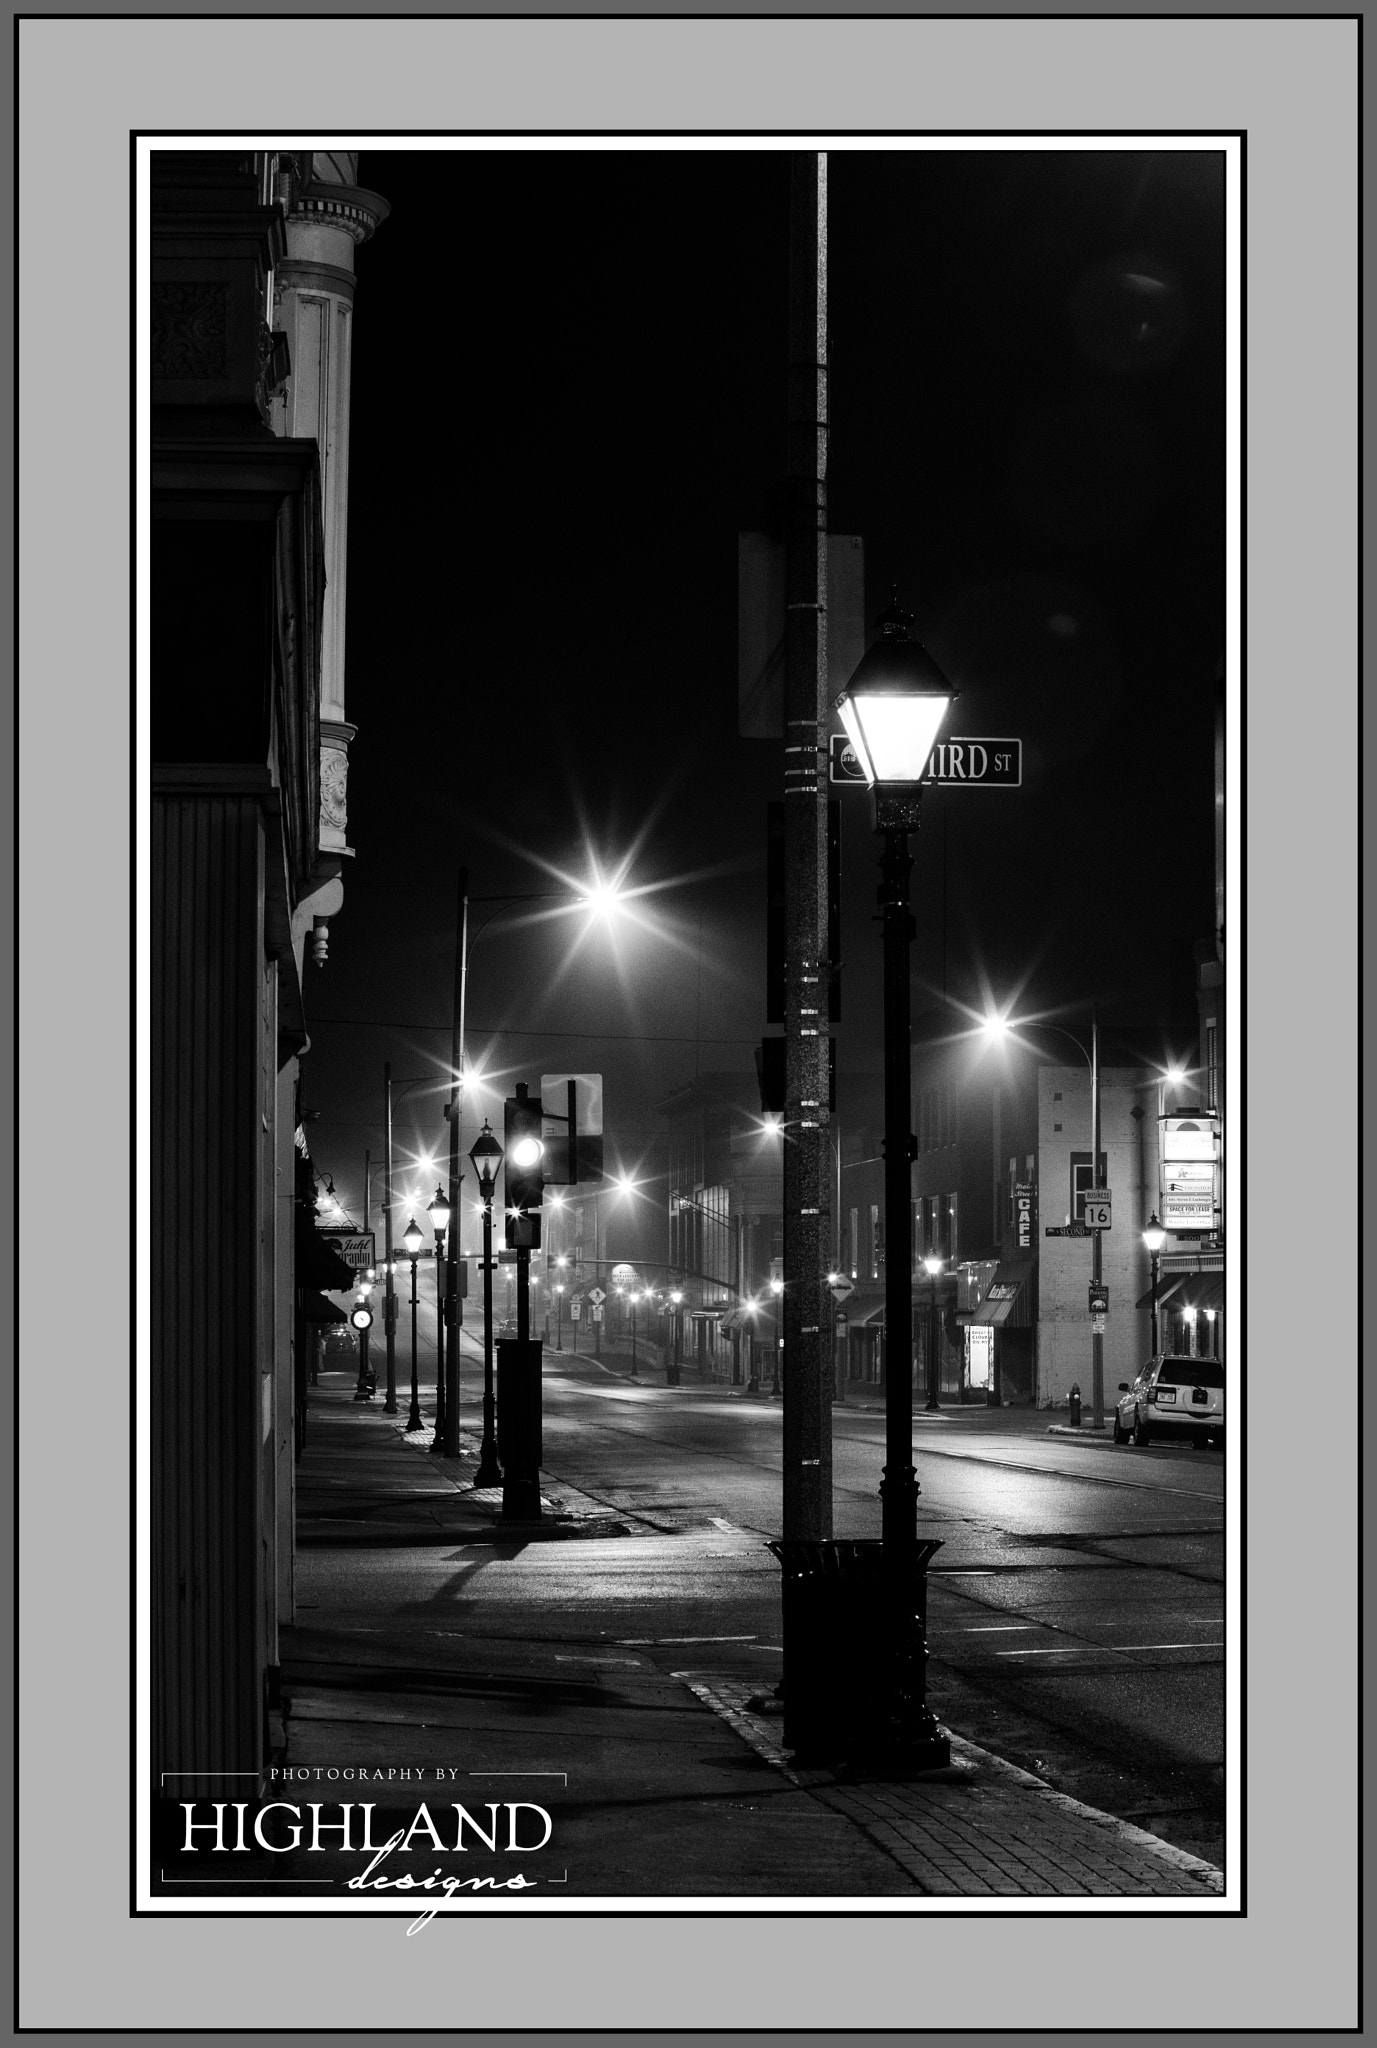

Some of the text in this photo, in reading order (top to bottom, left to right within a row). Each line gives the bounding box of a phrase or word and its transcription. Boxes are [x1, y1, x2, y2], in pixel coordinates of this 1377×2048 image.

[928, 744, 1012, 779] IRD ST
[1087, 1192, 1110, 1200] BUSINESS
[1018, 1198, 1031, 1247] CAFE
[1090, 1208, 1108, 1223] 16
